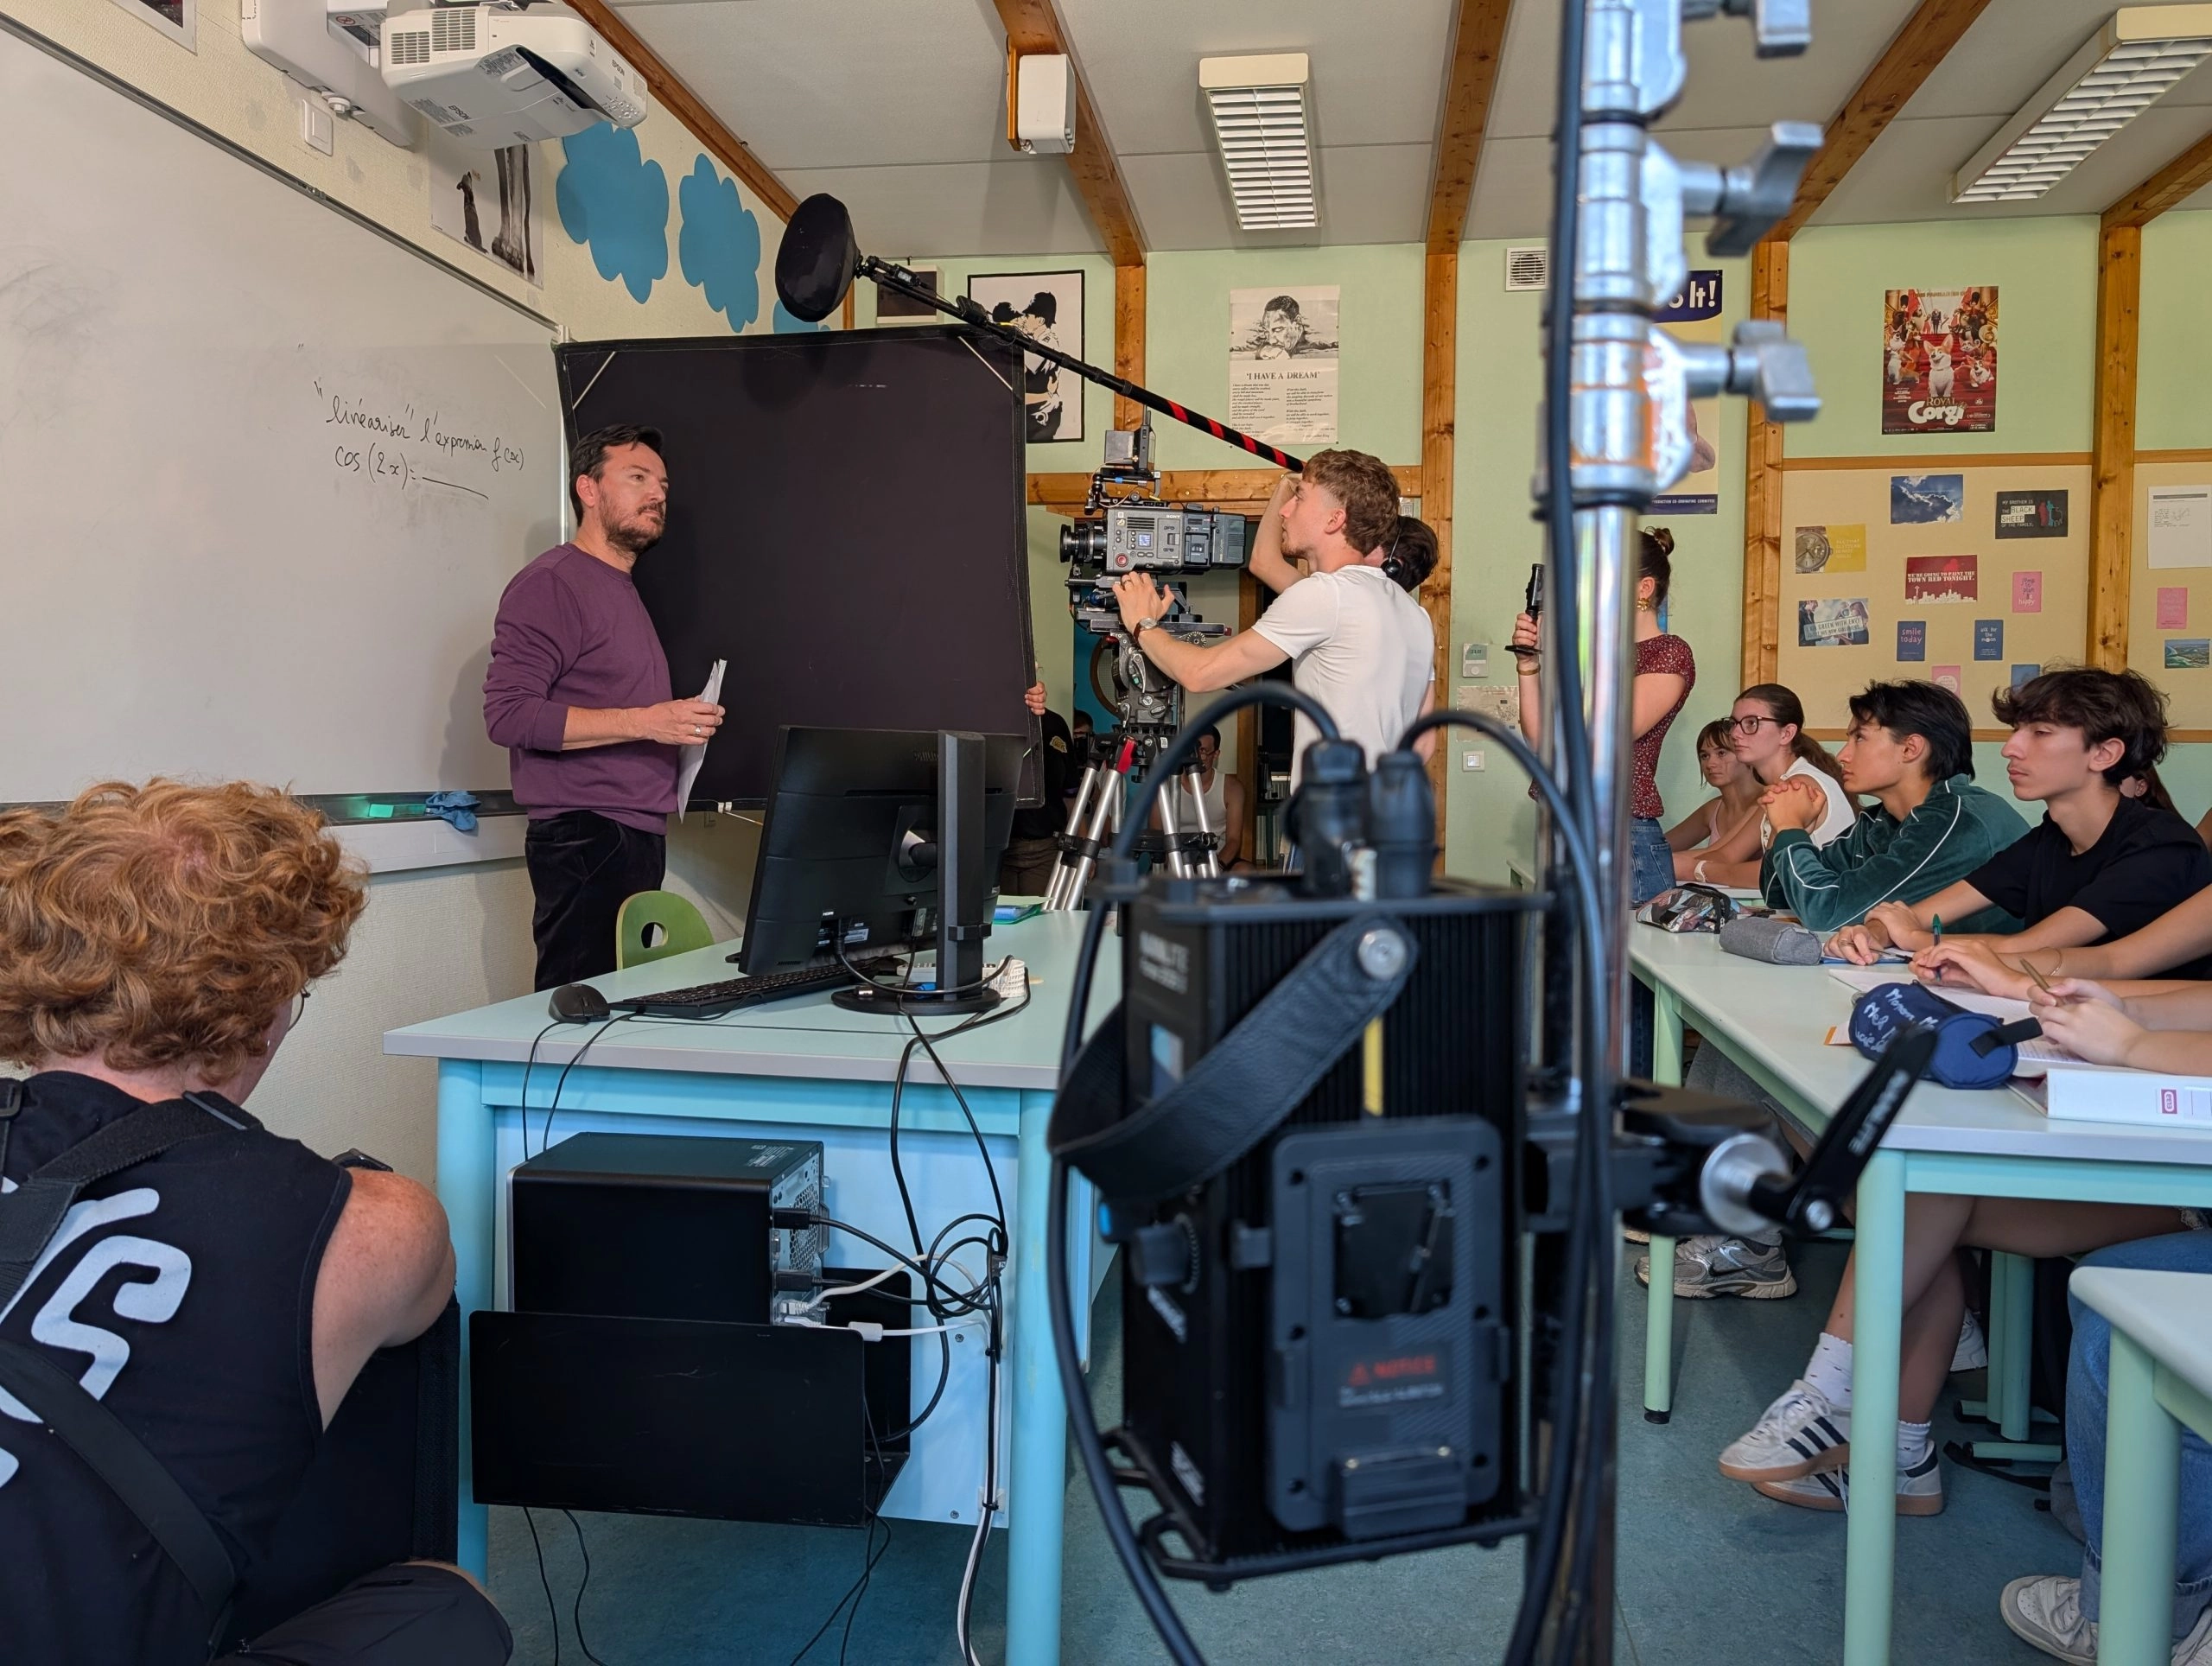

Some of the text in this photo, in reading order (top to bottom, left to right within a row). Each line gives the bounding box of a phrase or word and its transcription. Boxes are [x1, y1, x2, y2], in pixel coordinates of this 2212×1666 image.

[612, 60, 625, 76] EPSON
[448, 105, 471, 120] EPSON
[1689, 280, 1716, 308] It!
[1254, 372, 1276, 380] HAVE
[1277, 372, 1284, 380] A
[1908, 400, 1965, 426] Corgi
[1901, 627, 1922, 636] smile
[1901, 635, 1923, 645] today
